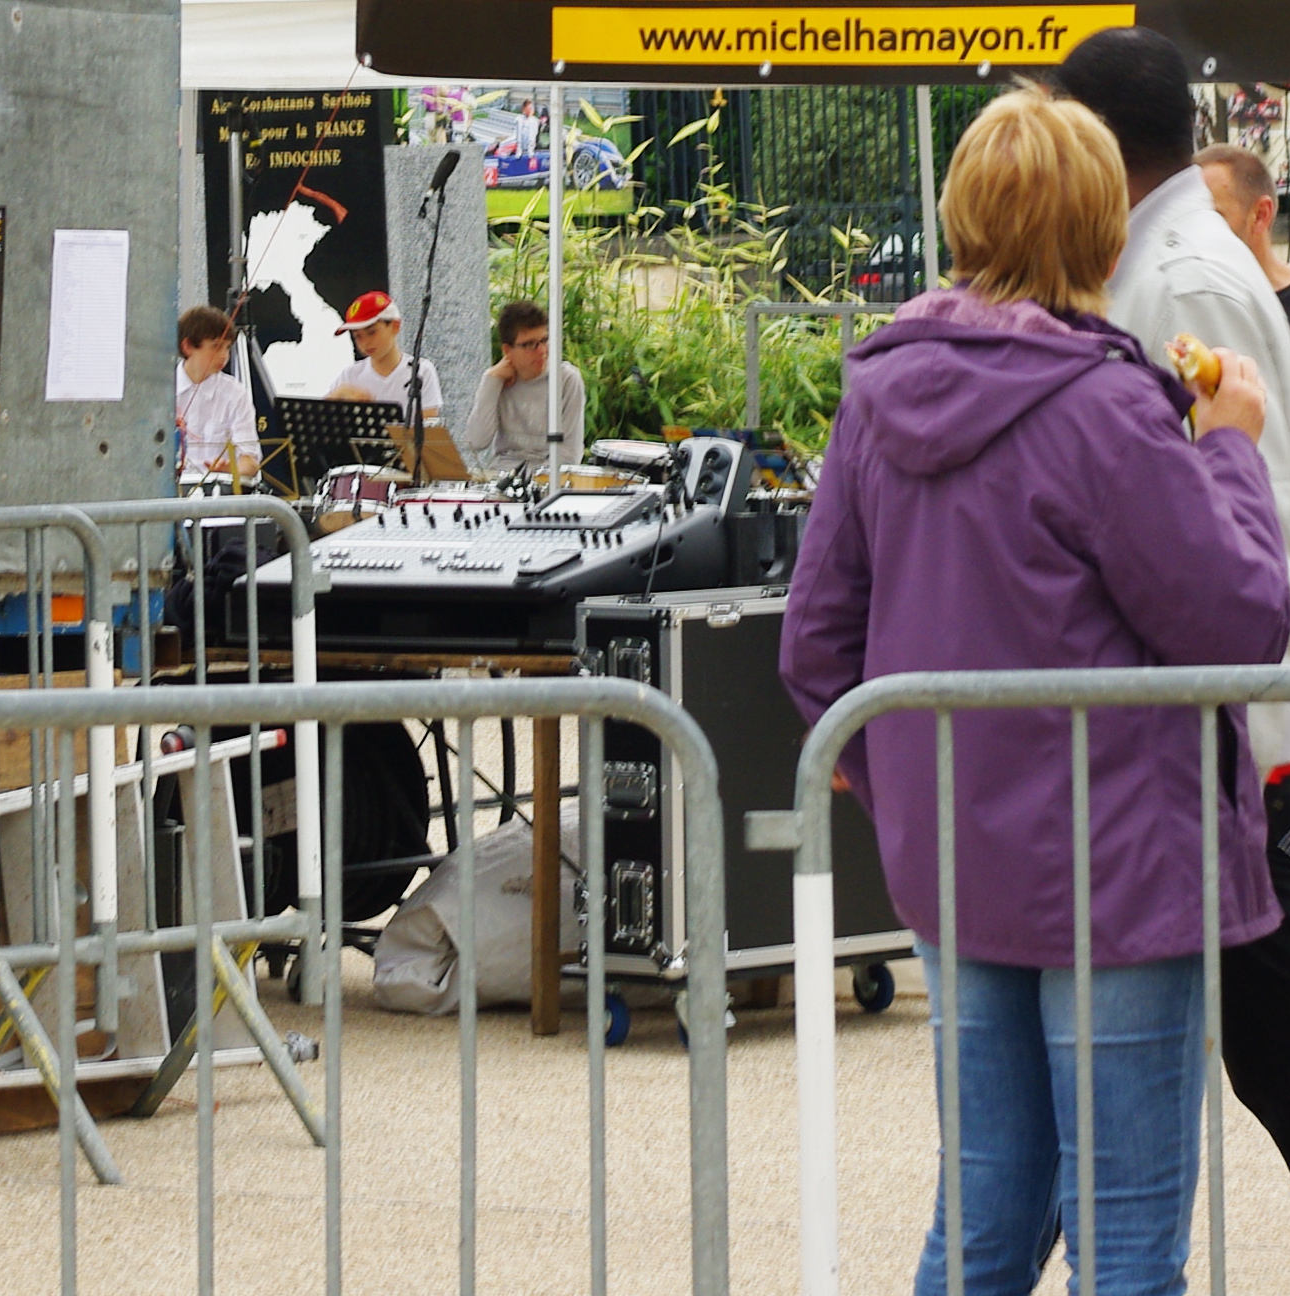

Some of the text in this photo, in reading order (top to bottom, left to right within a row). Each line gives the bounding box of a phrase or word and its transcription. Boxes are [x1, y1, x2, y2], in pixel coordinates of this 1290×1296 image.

[639, 16, 1068, 61] www.michelhamayon.fr
[260, 127, 289, 141] pour
[296, 123, 308, 139] la
[316, 119, 366, 138] FRANCE
[269, 149, 342, 168] INDOCHINE
